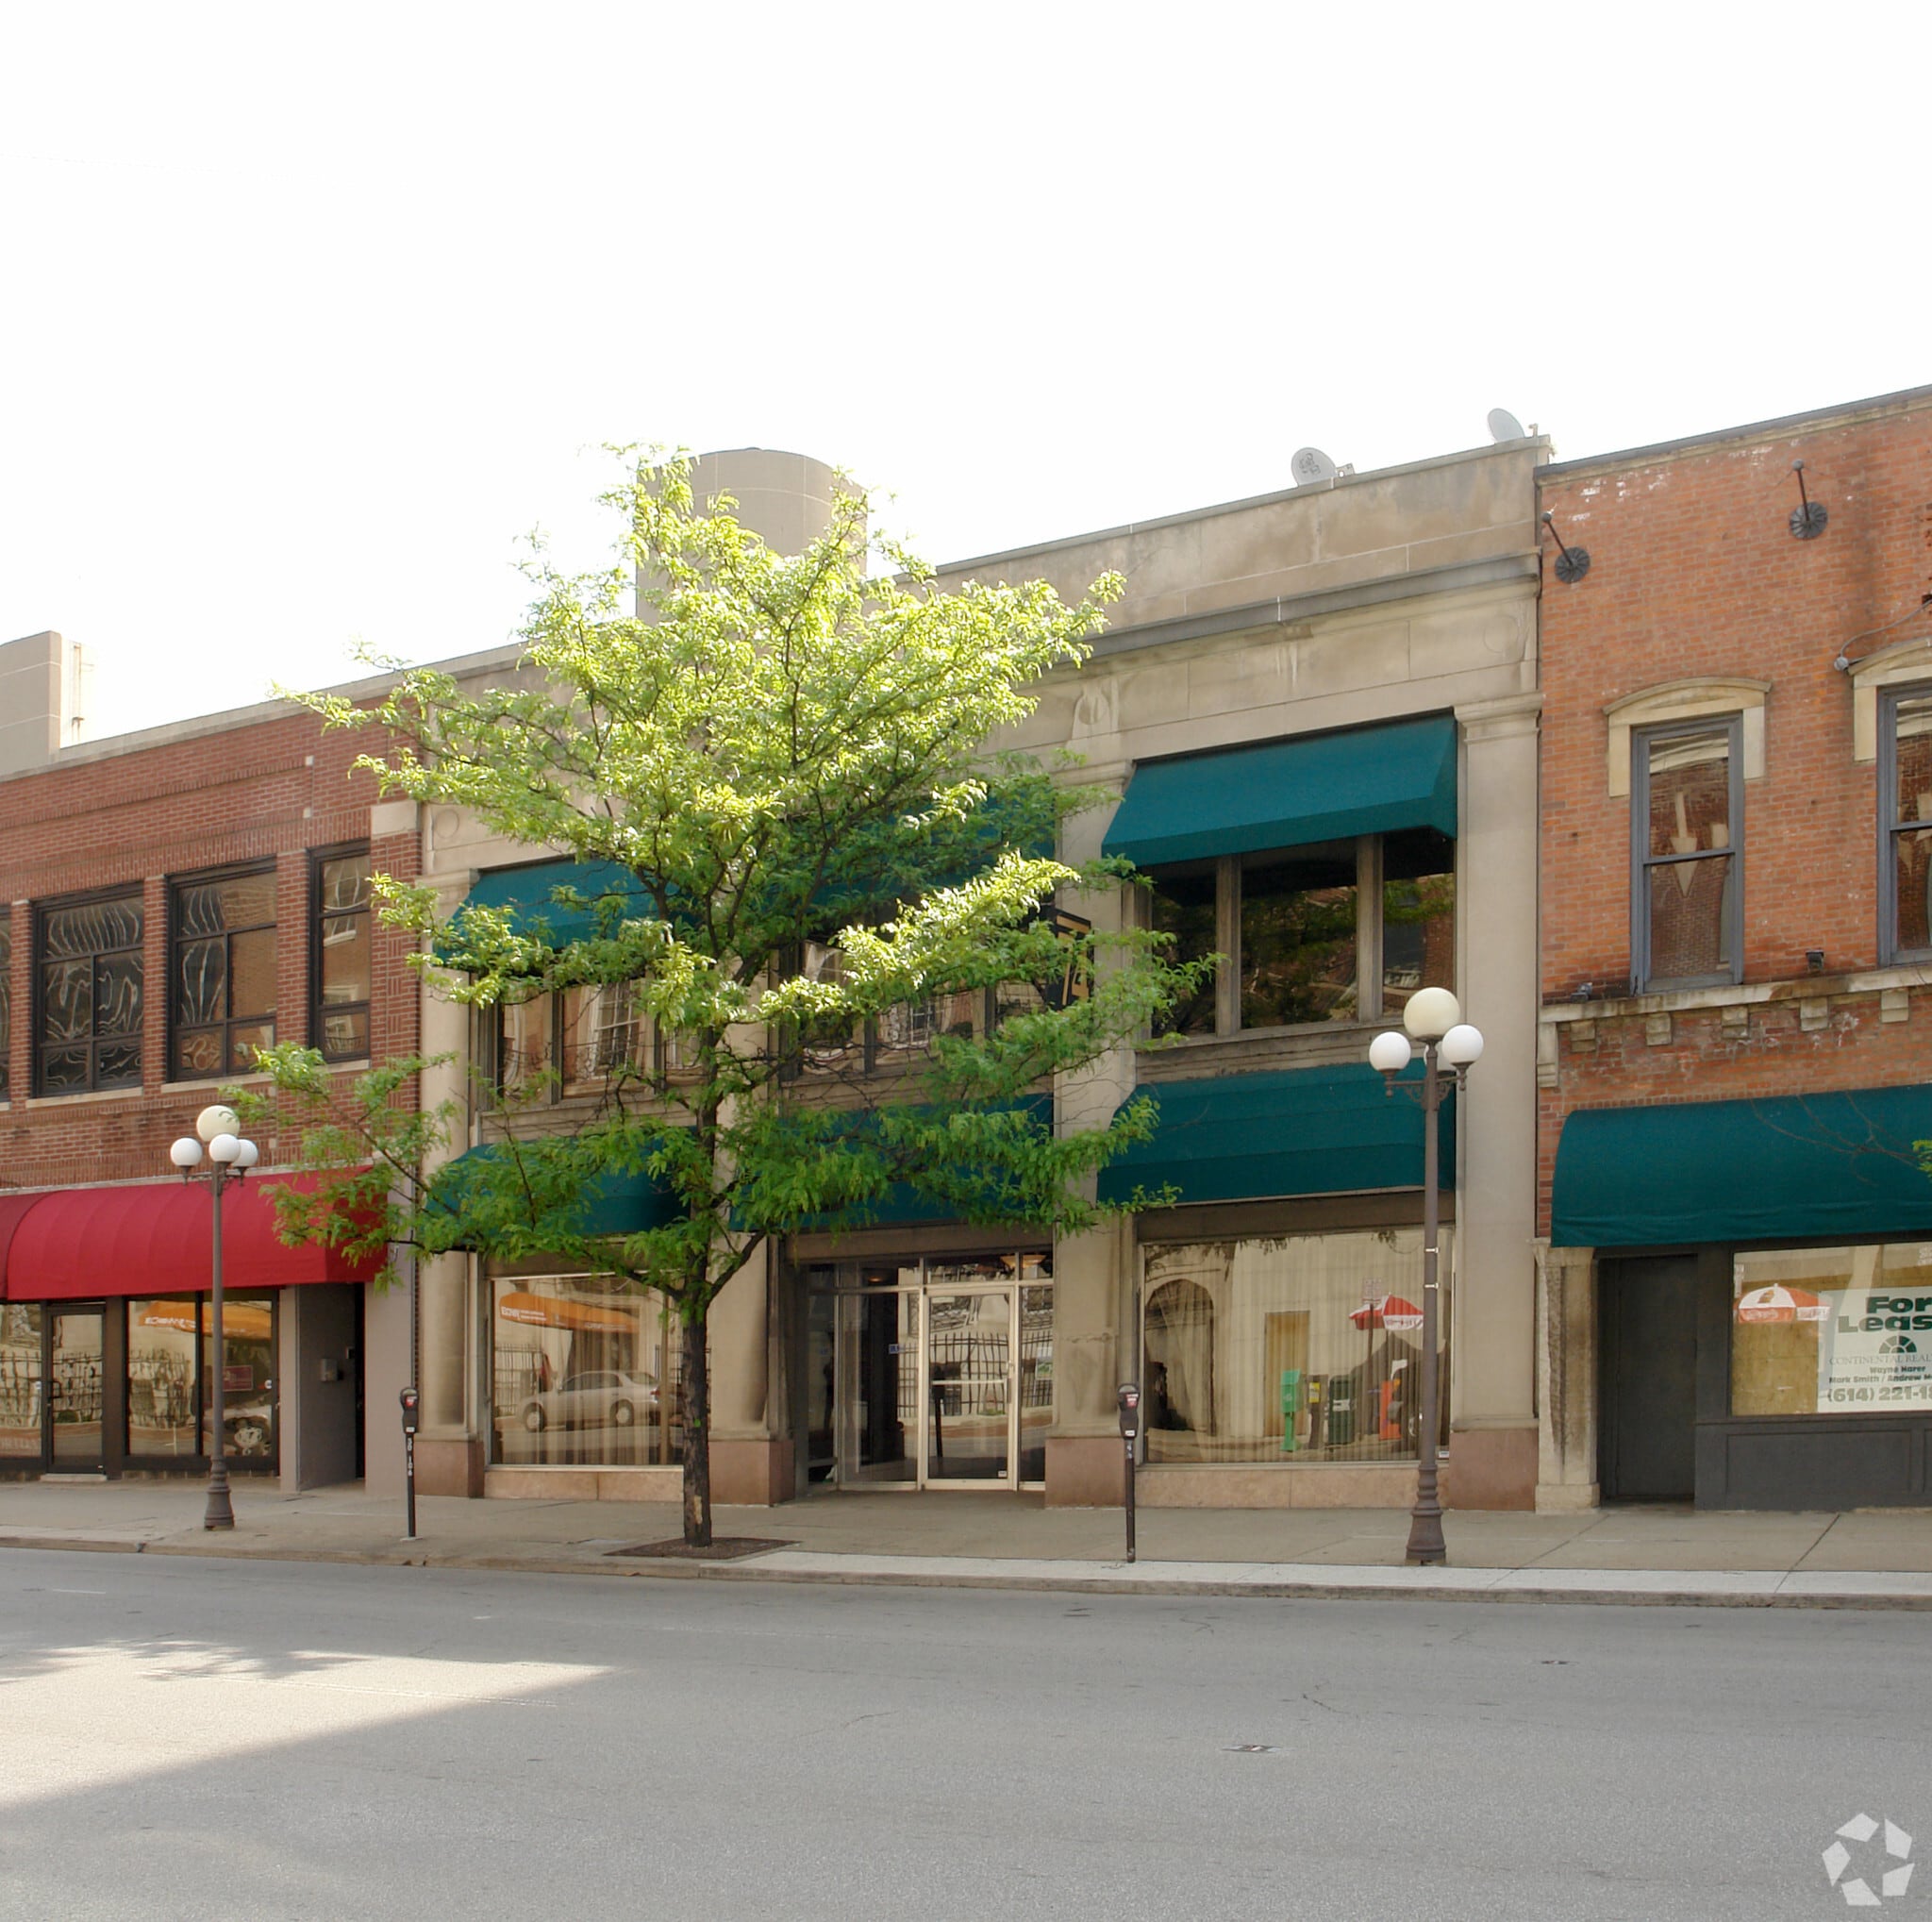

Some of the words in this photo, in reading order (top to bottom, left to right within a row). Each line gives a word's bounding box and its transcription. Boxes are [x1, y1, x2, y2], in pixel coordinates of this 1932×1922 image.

[1867, 1296, 1932, 1313] For
[1829, 1354, 1903, 1365] CONTINENTAL
[1906, 1353, 1932, 1362] REAL
[1854, 1375, 1879, 1383] Smith
[1887, 1374, 1922, 1382] Andrew
[1827, 1387, 1874, 1402] (614)
